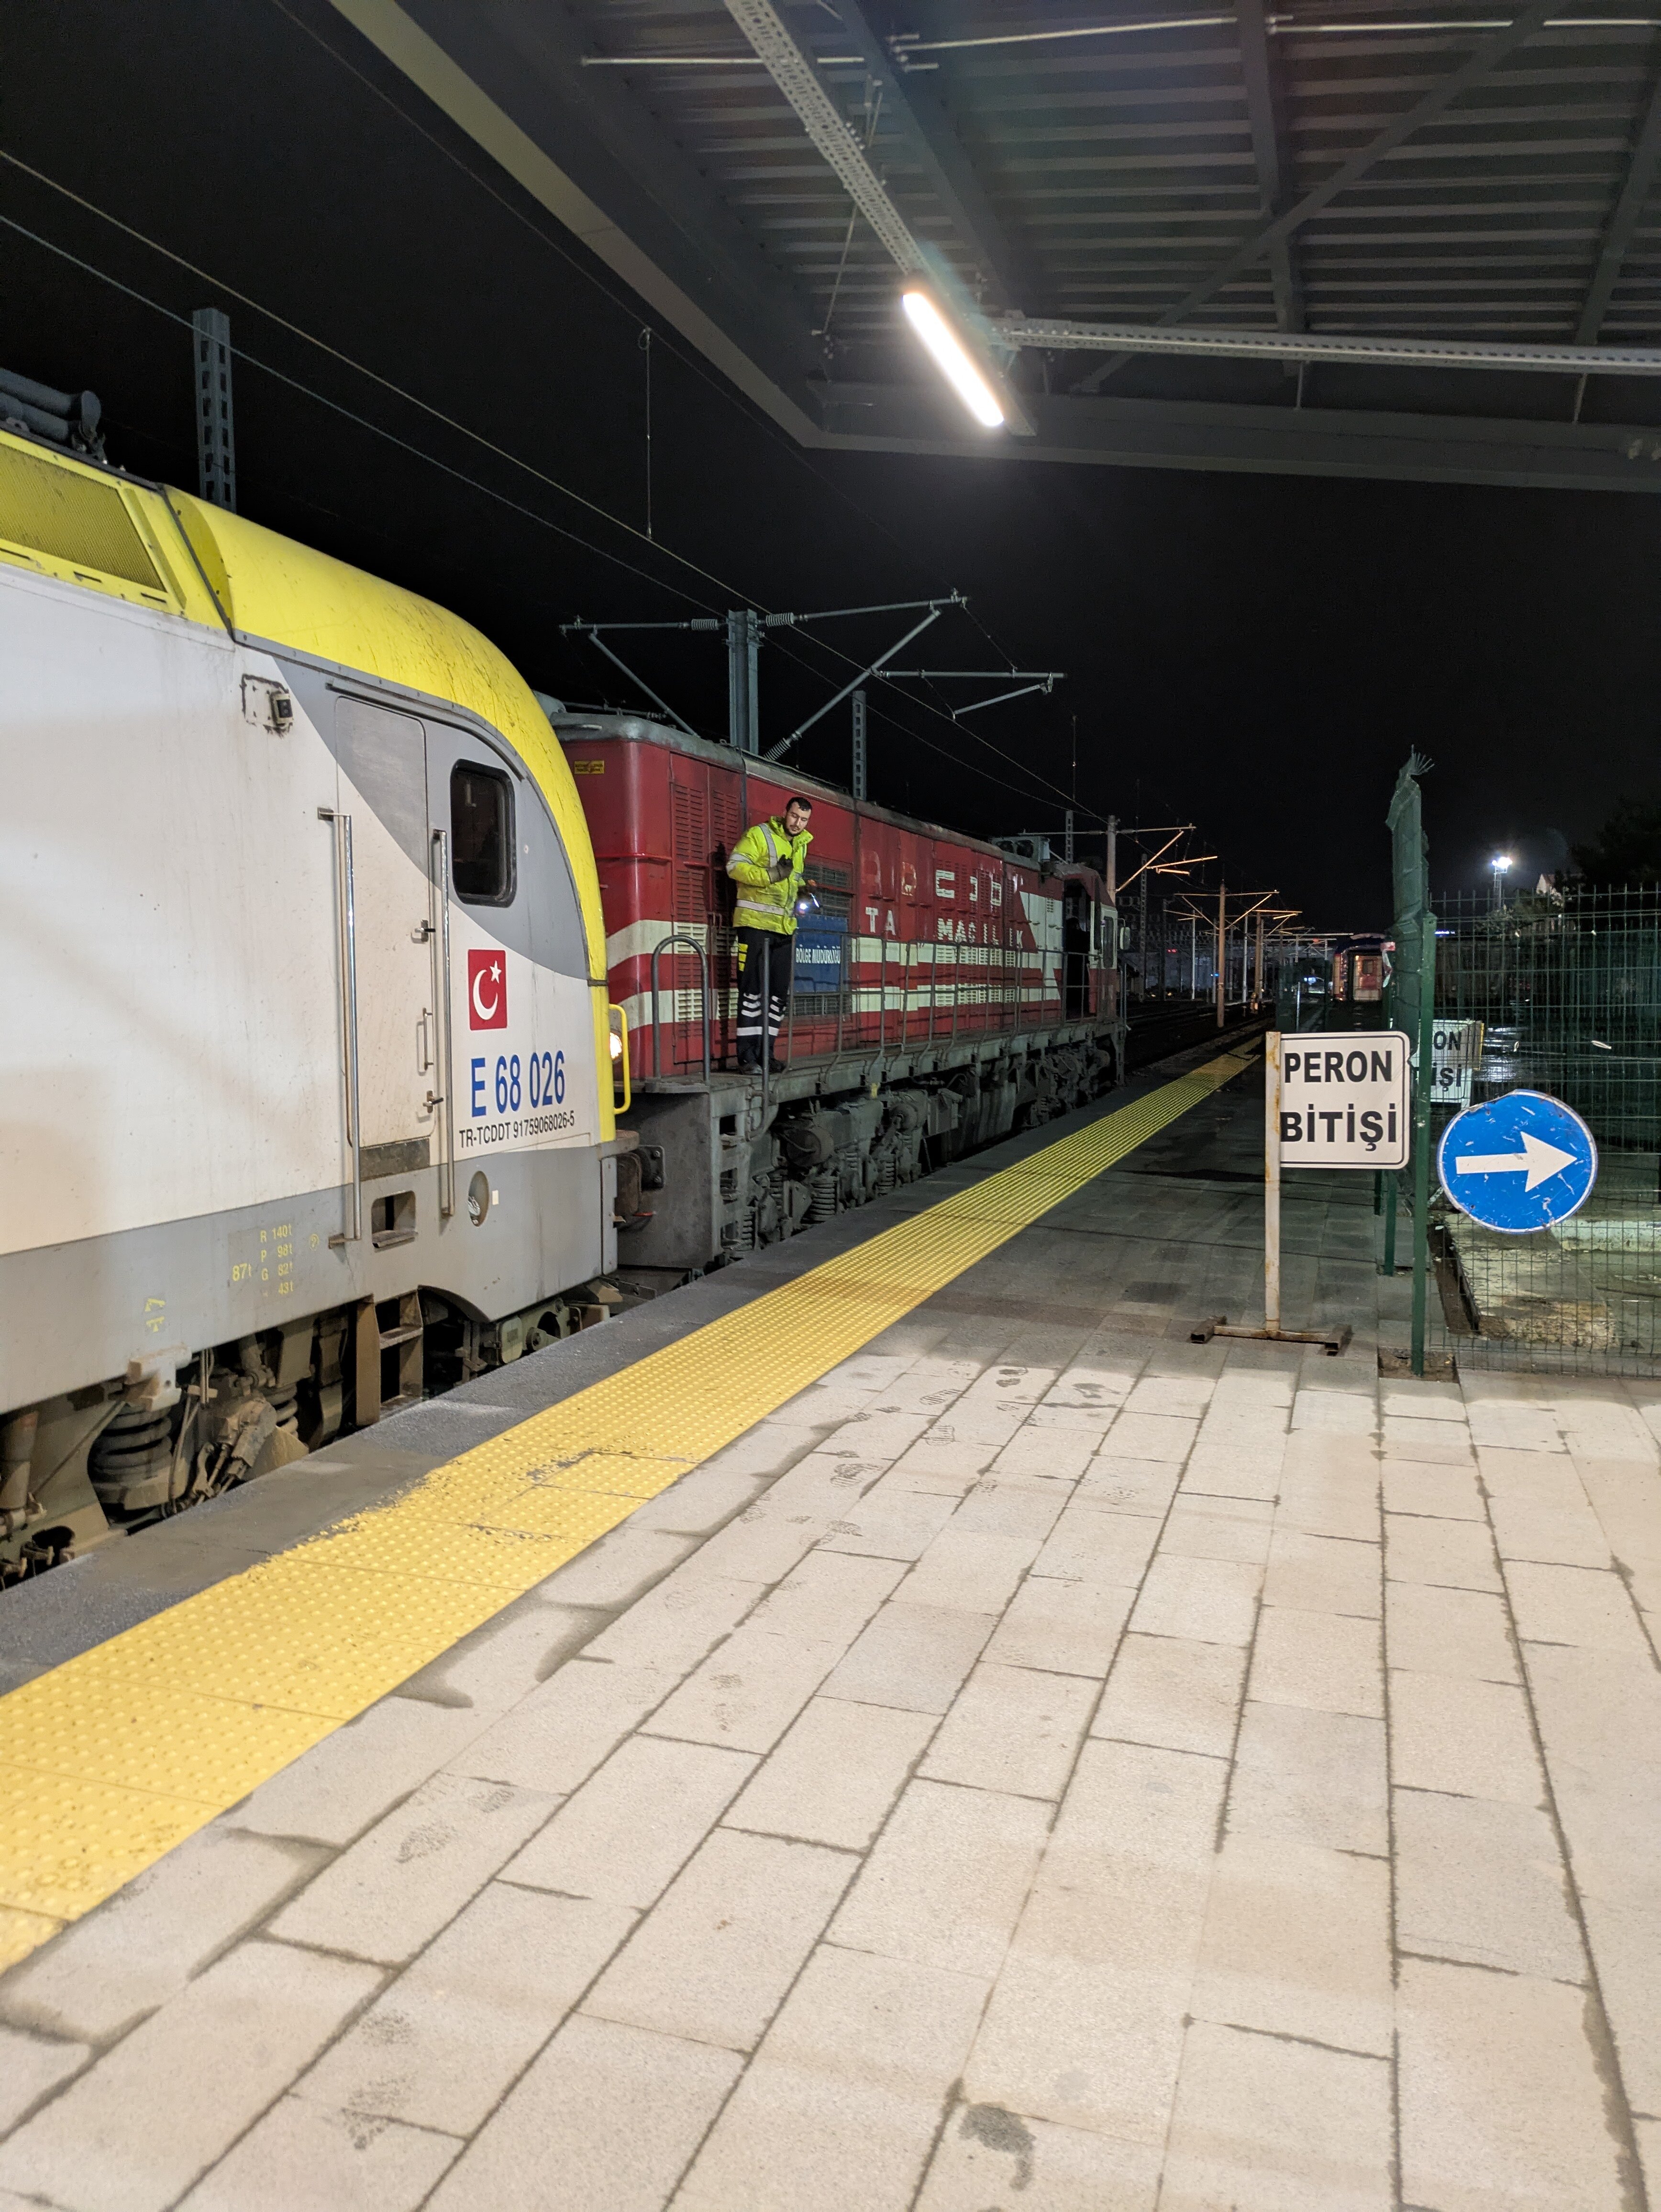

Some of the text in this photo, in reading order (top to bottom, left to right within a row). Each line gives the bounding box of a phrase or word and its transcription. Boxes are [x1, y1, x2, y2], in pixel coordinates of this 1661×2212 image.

[796, 944, 811, 963] BÖLGE
[1434, 1031, 1462, 1050] ON
[1285, 1051, 1393, 1083] PERON
[1432, 1062, 1462, 1092] İŞİ
[471, 1050, 565, 1117] E 68 026
[459, 1110, 575, 1148] TR-TCDDT 91759068026-5
[1280, 1103, 1397, 1151] BİTİŞİ
[261, 1250, 267, 1262] P
